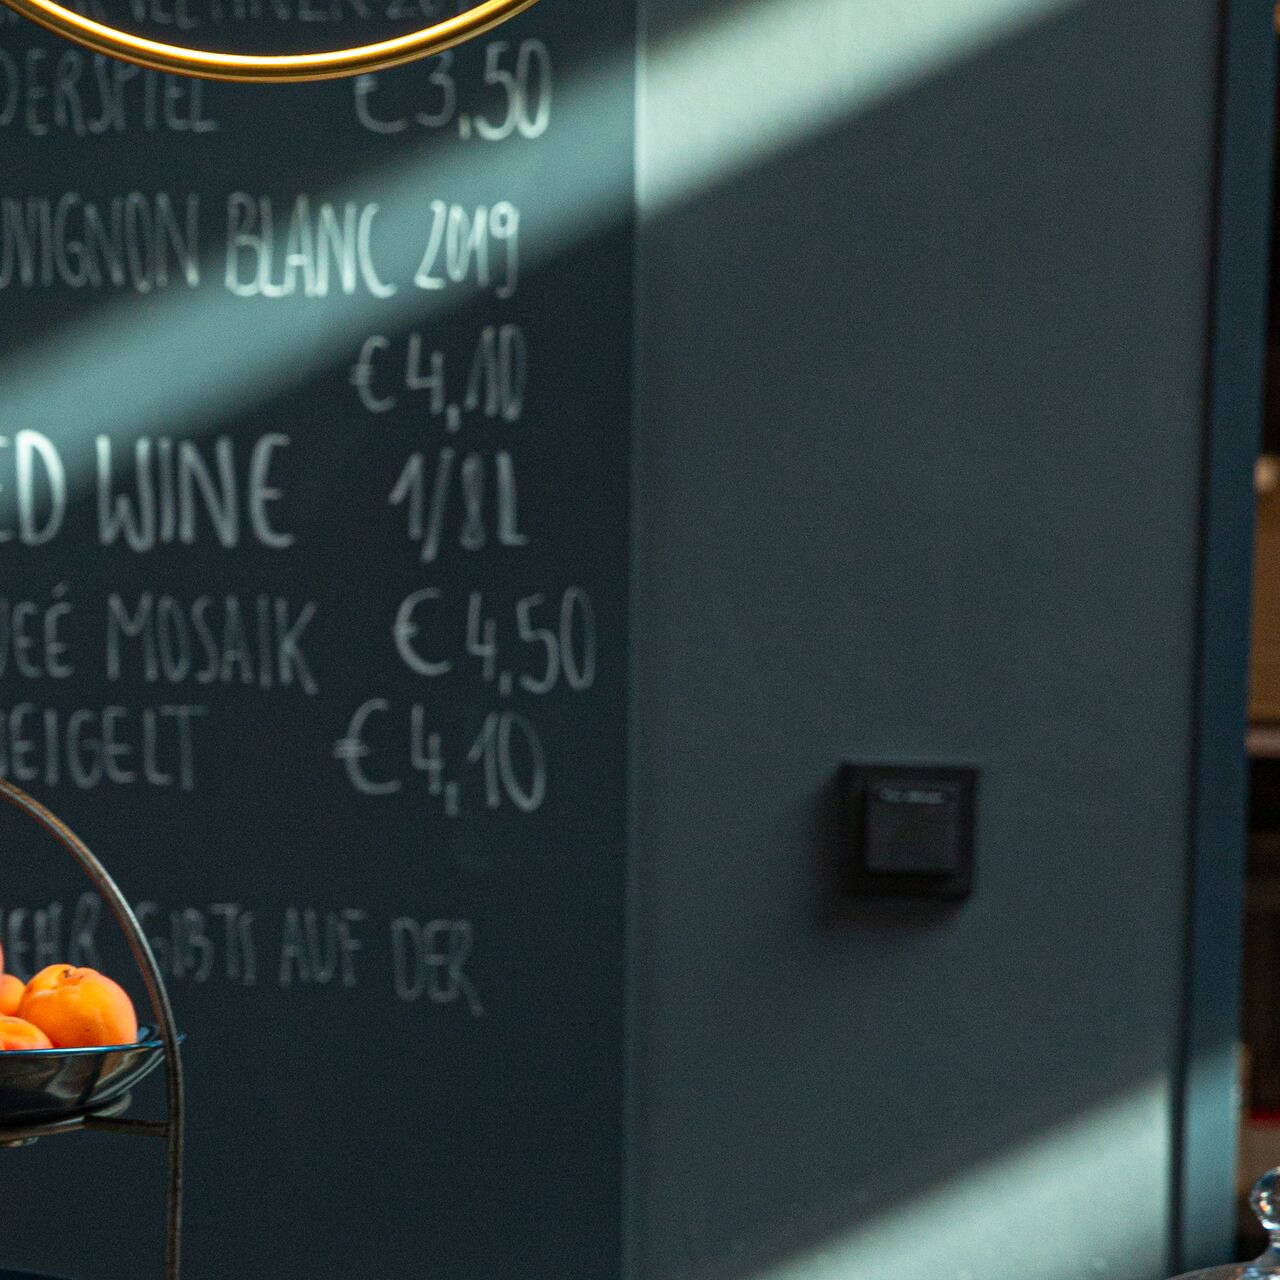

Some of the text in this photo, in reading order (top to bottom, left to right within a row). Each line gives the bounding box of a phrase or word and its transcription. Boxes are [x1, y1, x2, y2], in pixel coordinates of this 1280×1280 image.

[224, 190, 398, 300] BLANC
[413, 197, 523, 300] 2019
[95, 431, 297, 554] WINE
[105, 590, 319, 696] MOSAIK
[278, 905, 370, 989] AUF
[389, 915, 485, 1018] DER
